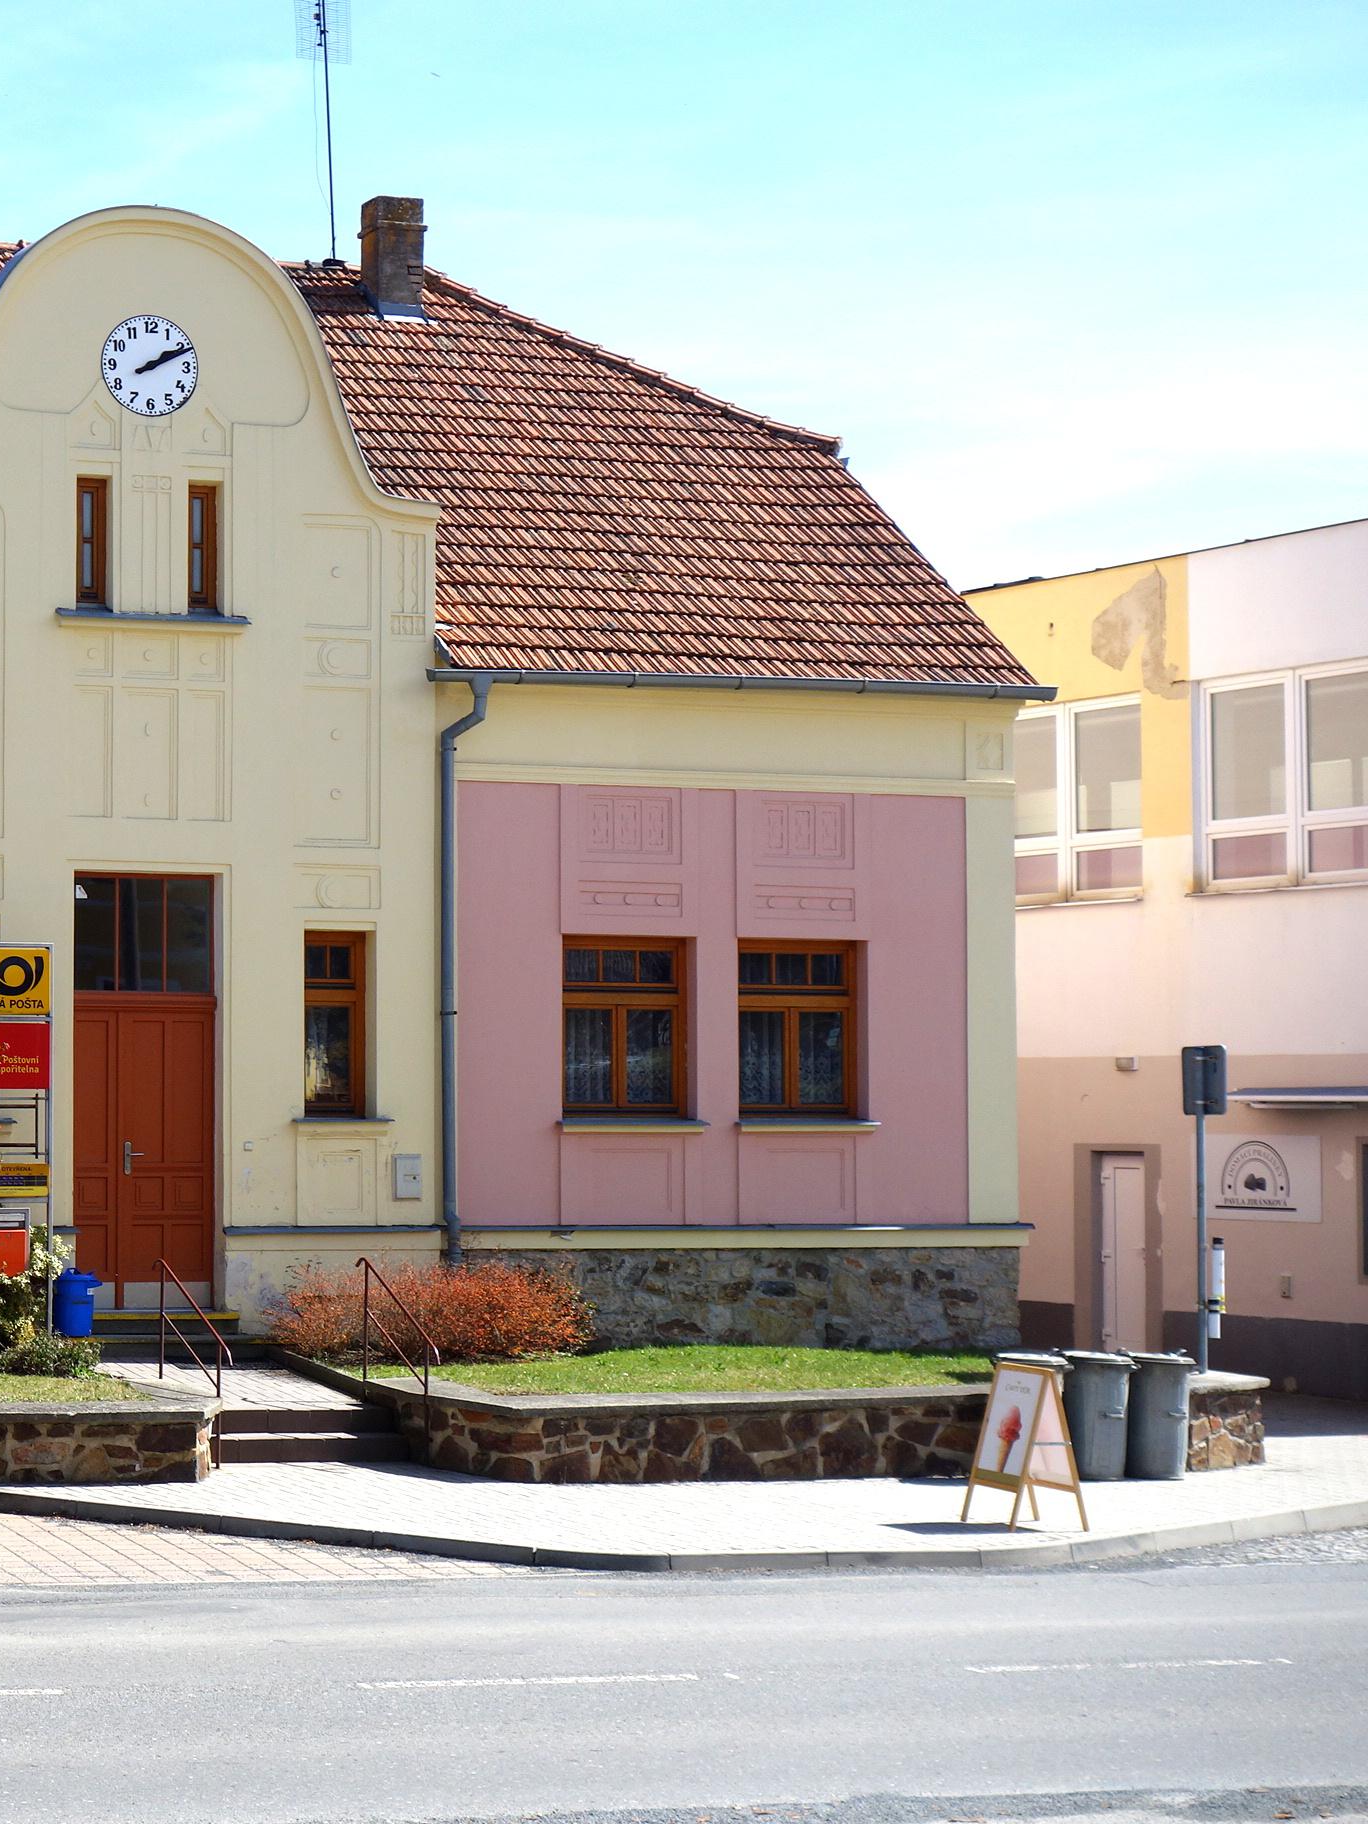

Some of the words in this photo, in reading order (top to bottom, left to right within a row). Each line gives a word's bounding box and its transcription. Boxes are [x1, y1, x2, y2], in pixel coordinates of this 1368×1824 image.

[127, 327, 137, 339] 11
[144, 321, 159, 334] 12
[165, 328, 170, 340] 1
[113, 339, 126, 352] 10
[108, 358, 117, 371] 9
[182, 361, 191, 374] 3
[113, 378, 123, 391] 8
[176, 380, 186, 393] 4
[129, 391, 139, 404] 7
[164, 393, 174, 406] 5
[146, 398, 155, 411] 6
[10, 997, 44, 1009] POŠTA
[3, 1056, 40, 1064] Poštovní
[1224, 1197, 1247, 1206] PAVLA
